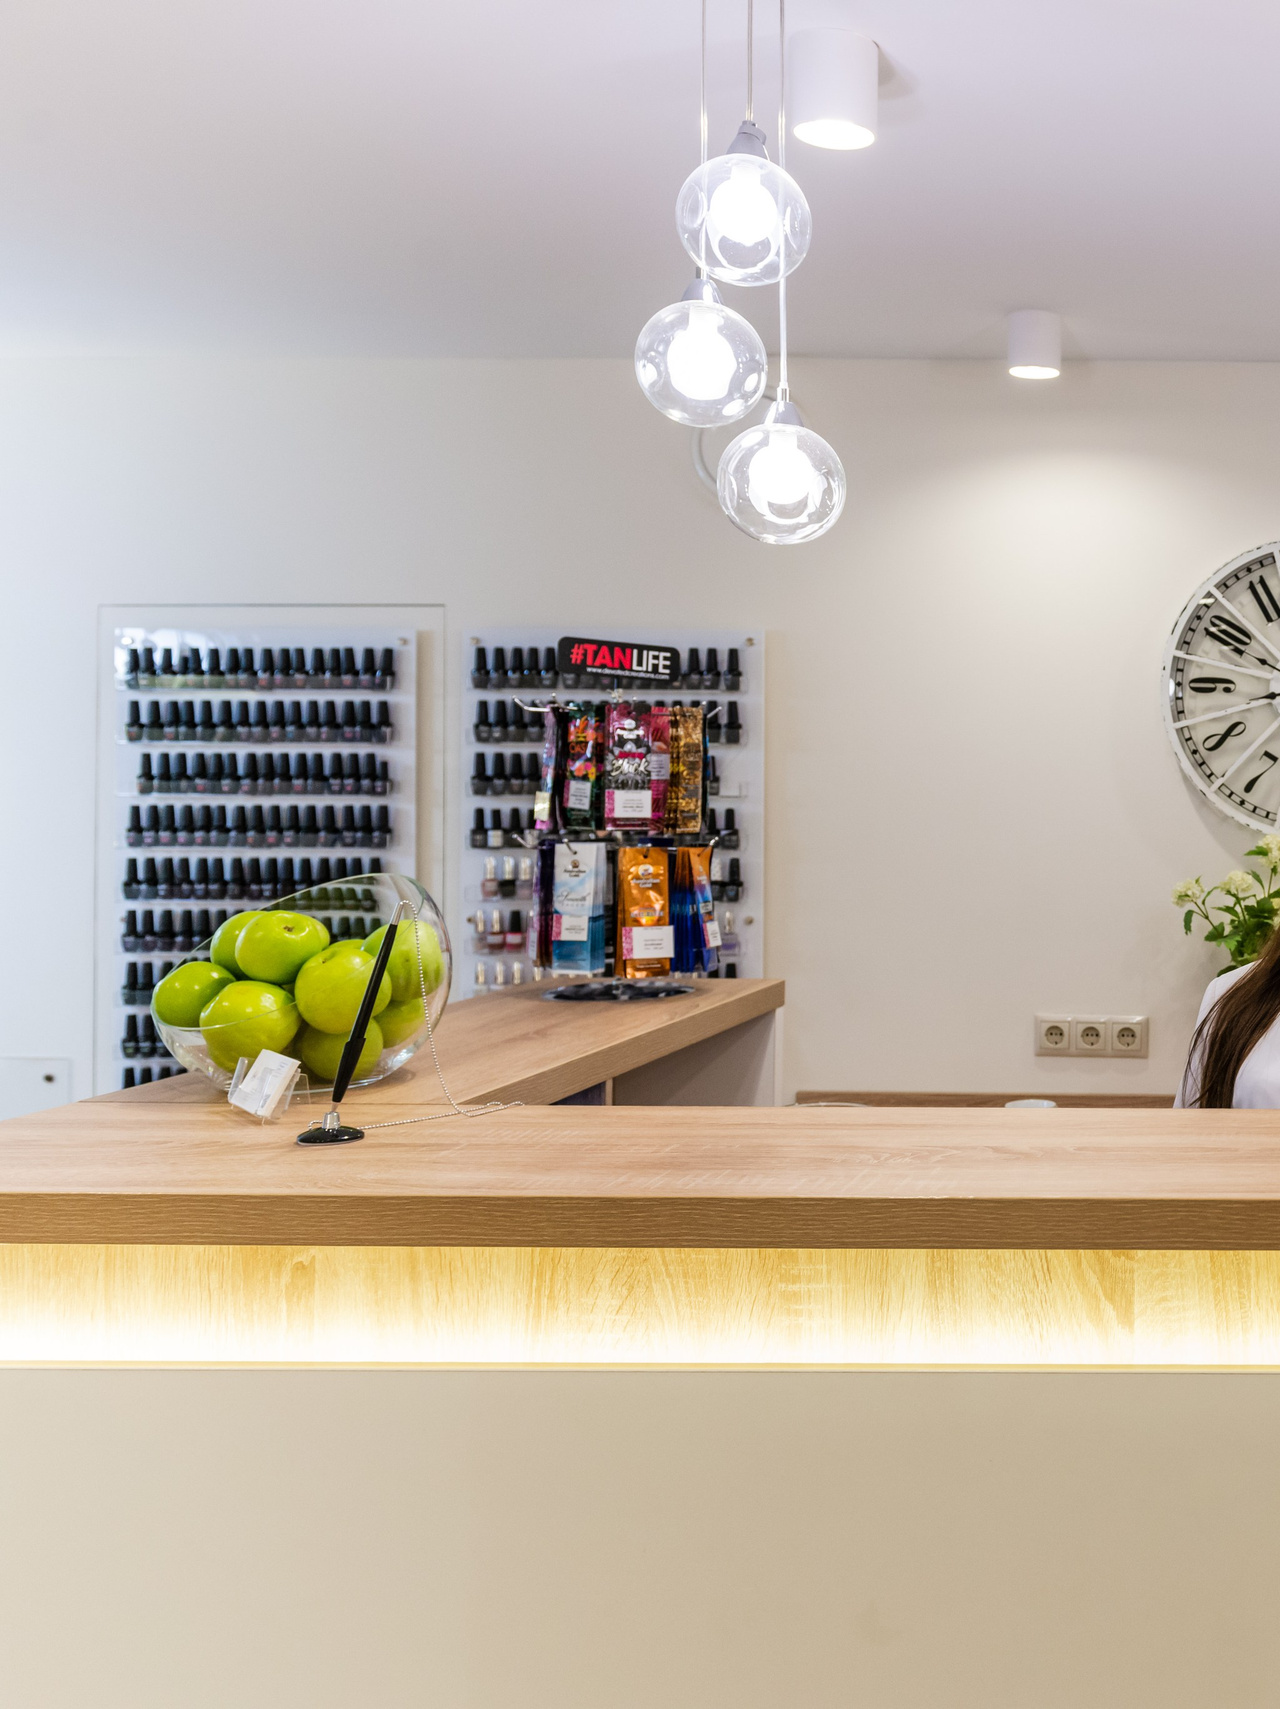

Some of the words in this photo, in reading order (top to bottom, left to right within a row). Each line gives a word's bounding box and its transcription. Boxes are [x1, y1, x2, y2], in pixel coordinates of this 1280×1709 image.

[1203, 614, 1252, 658] 10
[570, 643, 671, 674] #TANLIFE
[1188, 676, 1236, 694] 9
[1202, 721, 1247, 752] 8
[1243, 750, 1279, 794] 7
